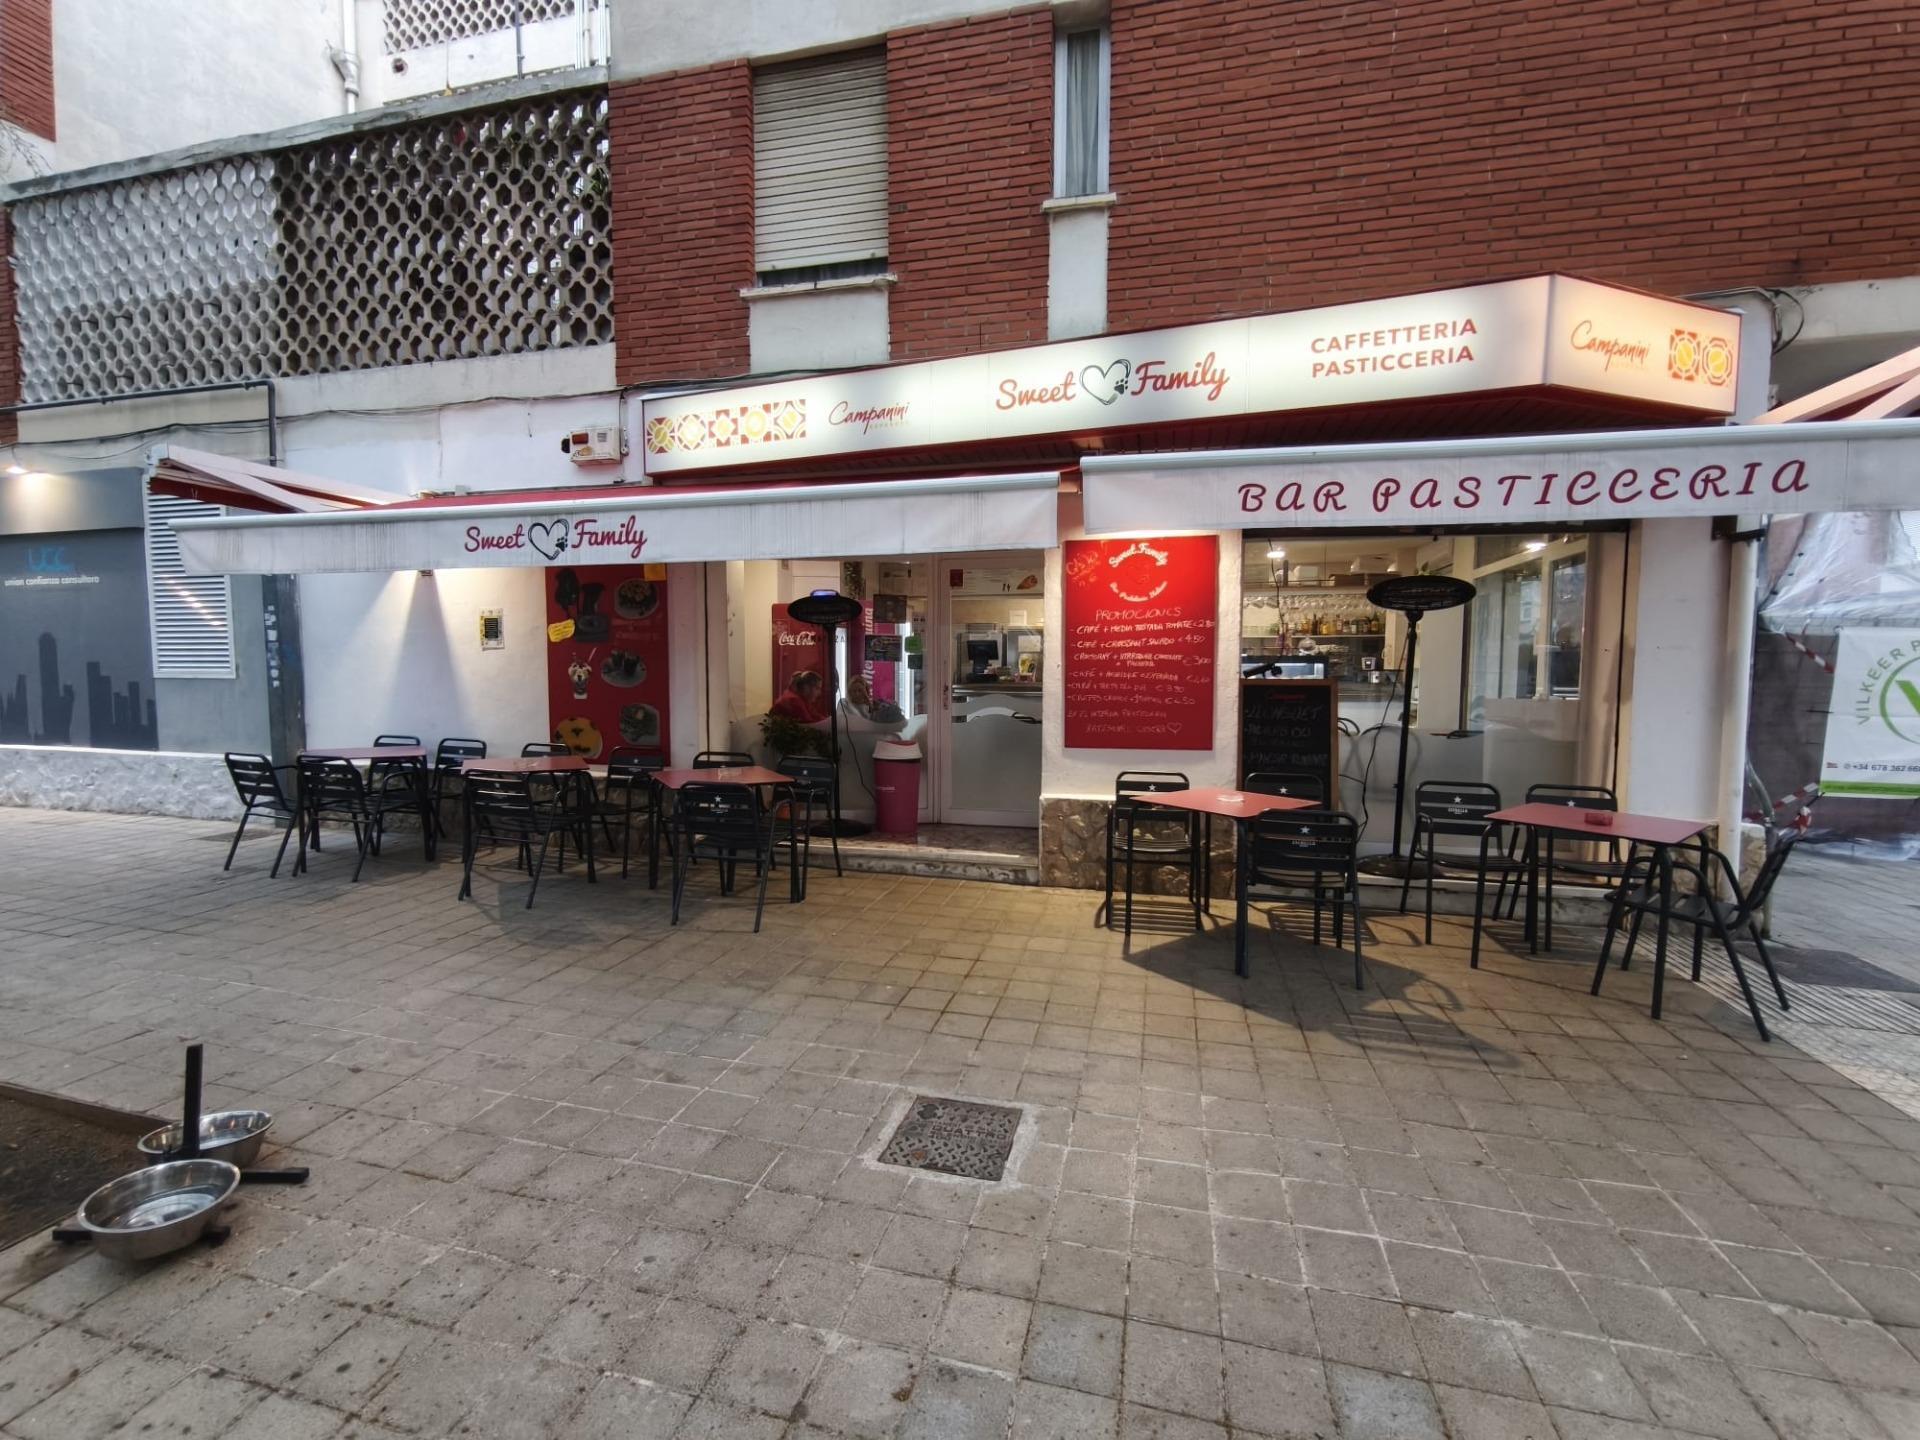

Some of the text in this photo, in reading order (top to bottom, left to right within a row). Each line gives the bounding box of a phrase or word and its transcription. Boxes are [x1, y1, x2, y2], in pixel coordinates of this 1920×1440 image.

[1310, 318, 1477, 353] CAFFETTERIA
[1570, 320, 1651, 372] Campanini
[996, 352, 1230, 410] Sweet Family
[1312, 345, 1474, 378] PASTICCERIA
[829, 401, 910, 434] Campanini
[1238, 459, 1809, 512] BAR PASTICCERIA
[464, 515, 647, 559] Sweet Family
[1855, 648, 1905, 725] VILKEER
